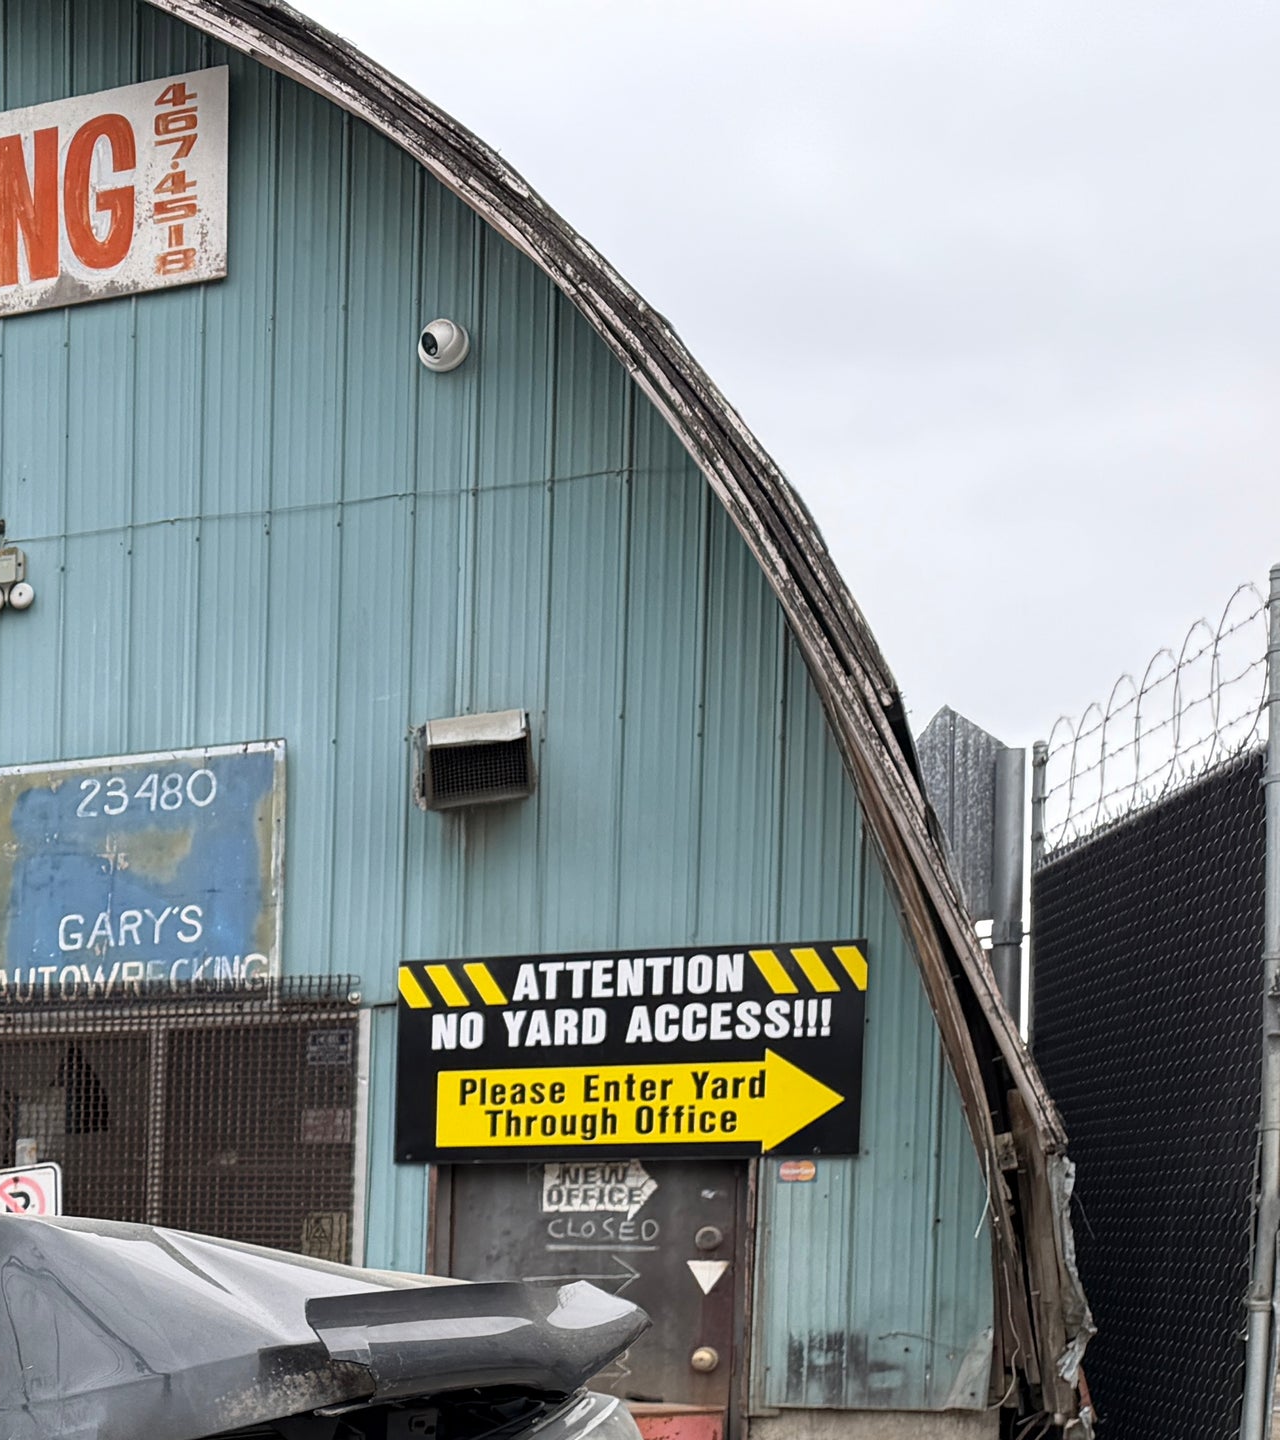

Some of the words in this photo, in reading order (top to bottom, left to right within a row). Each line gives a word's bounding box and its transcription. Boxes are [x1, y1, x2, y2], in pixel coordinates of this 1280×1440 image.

[76, 769, 218, 818] 23480
[58, 904, 204, 951] GARY'S
[512, 953, 745, 1001] ATTENTION
[431, 1011, 484, 1051] NO
[502, 1005, 608, 1047] YARD
[625, 998, 834, 1044] ACCESS!!!
[459, 1077, 566, 1106] Please
[583, 1074, 674, 1103] Enter
[691, 1069, 766, 1100] Yard
[485, 1106, 618, 1141] Through
[639, 1105, 738, 1135] Office
[560, 1164, 626, 1184] NEW
[546, 1184, 642, 1206] OFFICE
[547, 1217, 659, 1241] CLOSED
